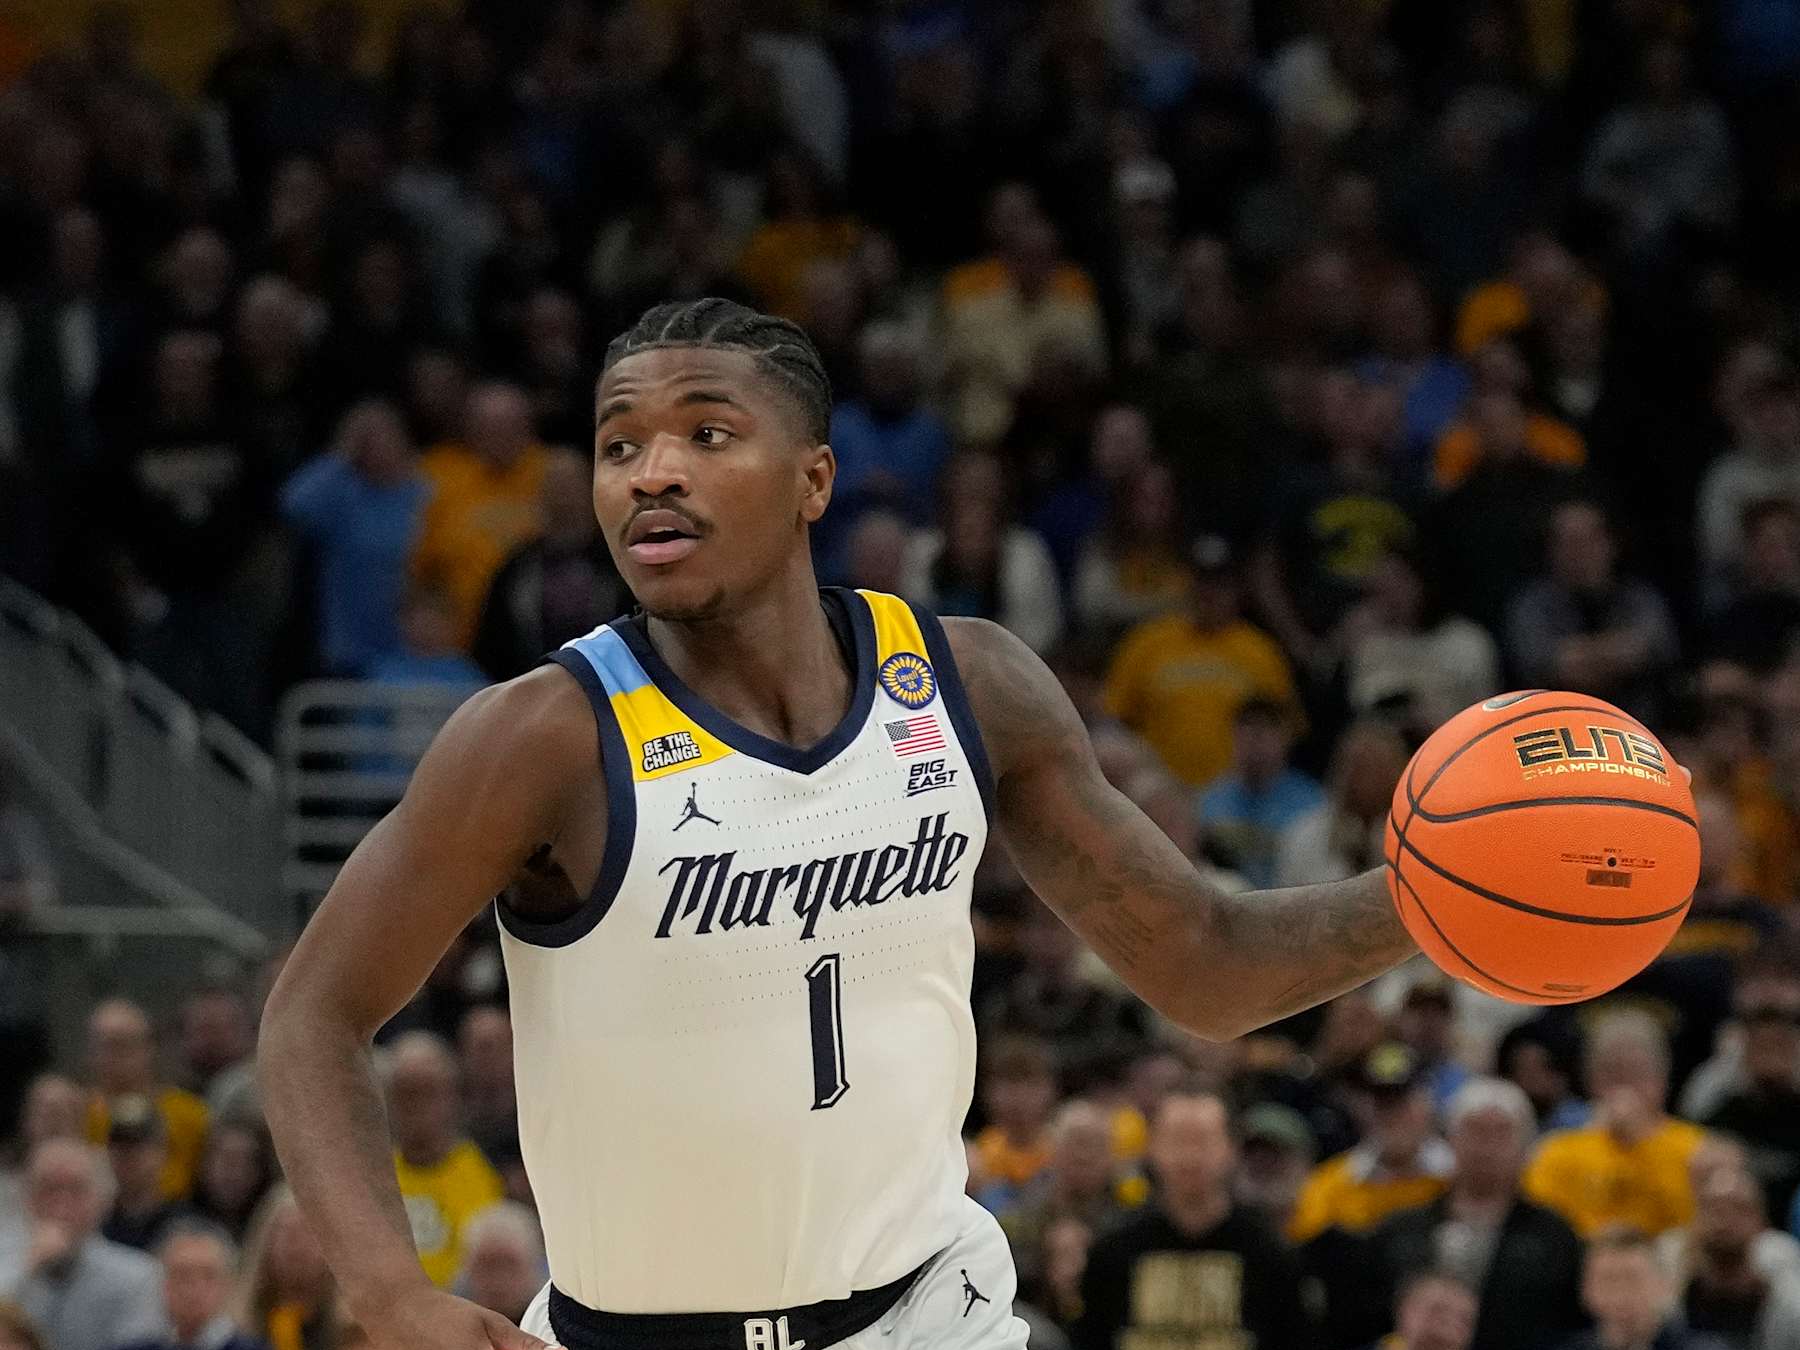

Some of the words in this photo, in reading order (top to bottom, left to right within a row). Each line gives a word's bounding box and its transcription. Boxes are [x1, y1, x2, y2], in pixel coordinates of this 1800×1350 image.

[643, 738, 665, 757] BE
[665, 732, 693, 749] THE
[643, 744, 701, 771] CHANGE
[1513, 725, 1667, 775] ELITE
[907, 770, 958, 790] EAST
[910, 759, 945, 776] BIG
[654, 811, 968, 940] Marquette
[804, 953, 850, 1110] 1
